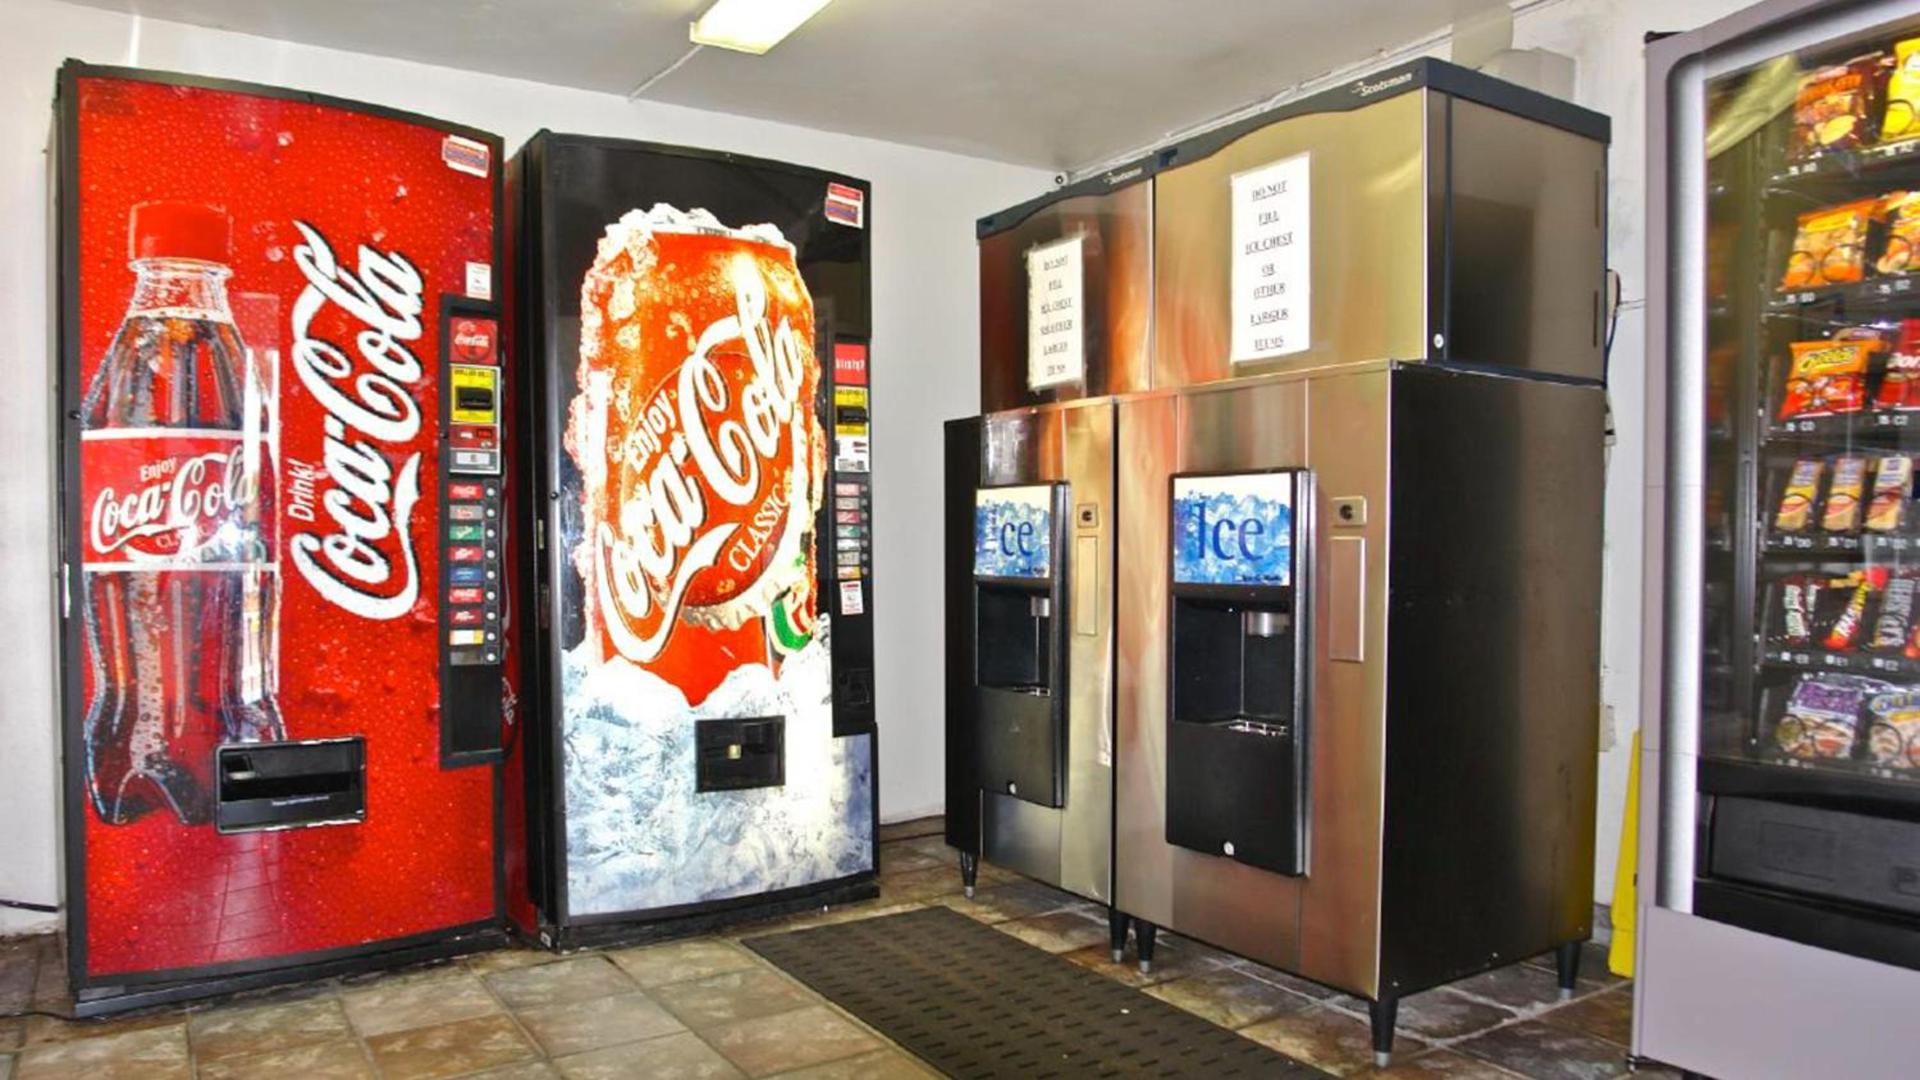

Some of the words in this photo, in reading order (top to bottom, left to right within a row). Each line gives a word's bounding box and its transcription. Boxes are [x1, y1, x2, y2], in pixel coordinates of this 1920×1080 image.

[1252, 184, 1264, 201] DO
[1267, 179, 1287, 197] NOT
[1258, 210, 1280, 226] FILL
[1245, 240, 1262, 255] ICE
[1263, 231, 1293, 252] CHEST
[1261, 262, 1276, 278] OR
[1253, 281, 1286, 299] OTHER
[1250, 307, 1288, 326] LARGER
[1254, 335, 1284, 352] ITEMS
[290, 219, 426, 619] Coca-Cola
[626, 390, 676, 474] Enjoy
[597, 252, 803, 661] Coca-Cola
[139, 457, 176, 482] Enjoy
[91, 445, 258, 554] Coca-Cola
[288, 458, 316, 522] Drink!
[727, 480, 788, 572] CLASSIC
[1193, 501, 1265, 561] Ice
